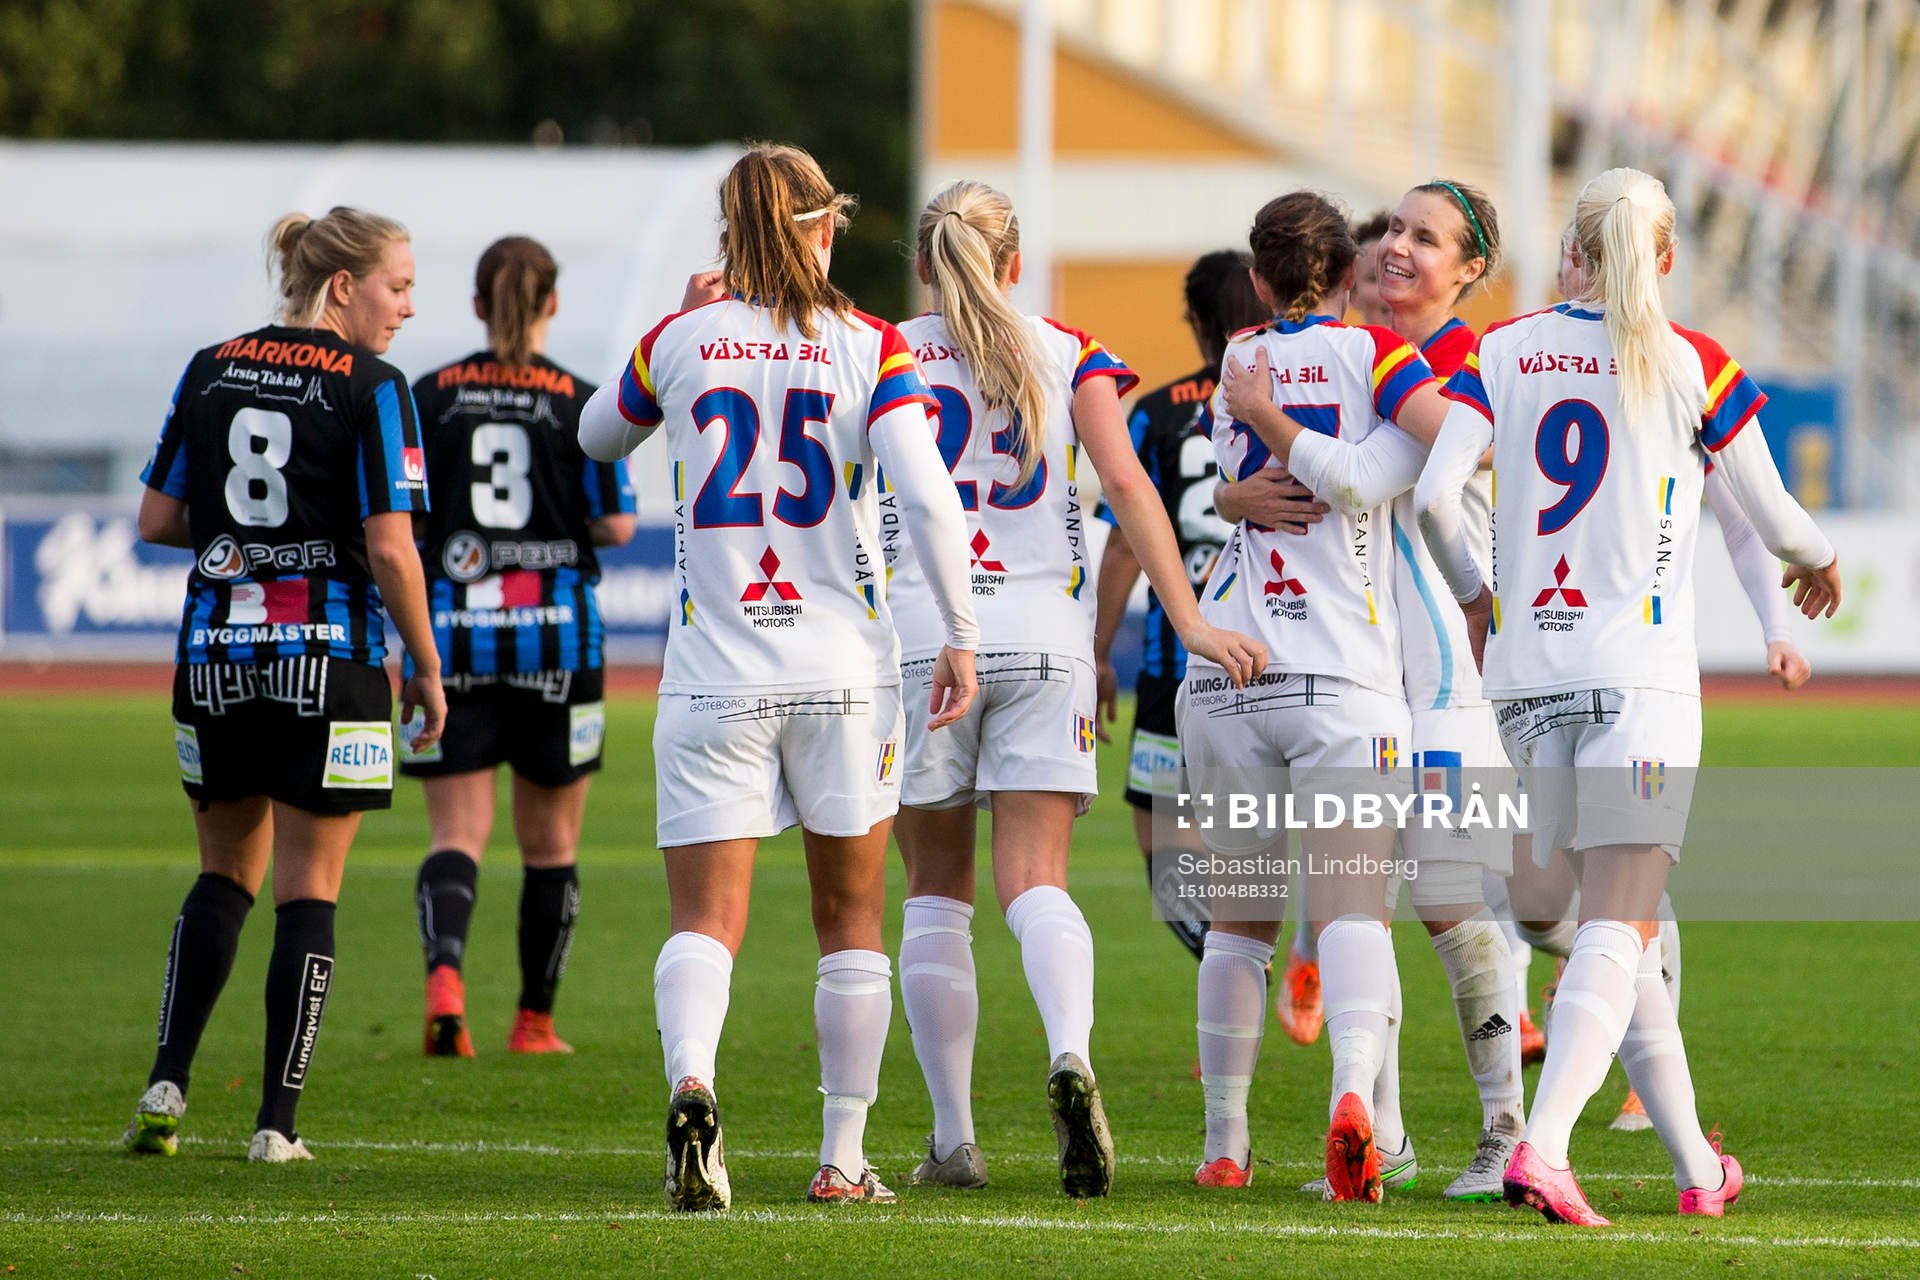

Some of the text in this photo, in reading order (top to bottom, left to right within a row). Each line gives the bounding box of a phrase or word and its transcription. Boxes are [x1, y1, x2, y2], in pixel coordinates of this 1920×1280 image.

[214, 337, 353, 376] MARKONA
[700, 337, 789, 361] VÄSTRA
[222, 360, 303, 388] Årsta Takab
[1519, 351, 1599, 375] VÄSTRA
[224, 407, 292, 528] 8
[691, 386, 836, 529] 25
[1535, 398, 1611, 536] 9
[470, 423, 532, 529] 3
[242, 540, 337, 571] PQR
[970, 574, 1005, 585] UBISHI
[971, 586, 996, 596] TORS
[744, 605, 802, 617] MITSUBISHI
[753, 617, 795, 628] MOTORS
[1271, 607, 1308, 621] MOTORS
[192, 623, 346, 646] BYGGMÄSTER
[1538, 621, 1574, 632] MOTORS
[331, 743, 389, 767] RELITA
[292, 996, 323, 1080] Lundqvist
[1469, 1023, 1512, 1041] adidas
